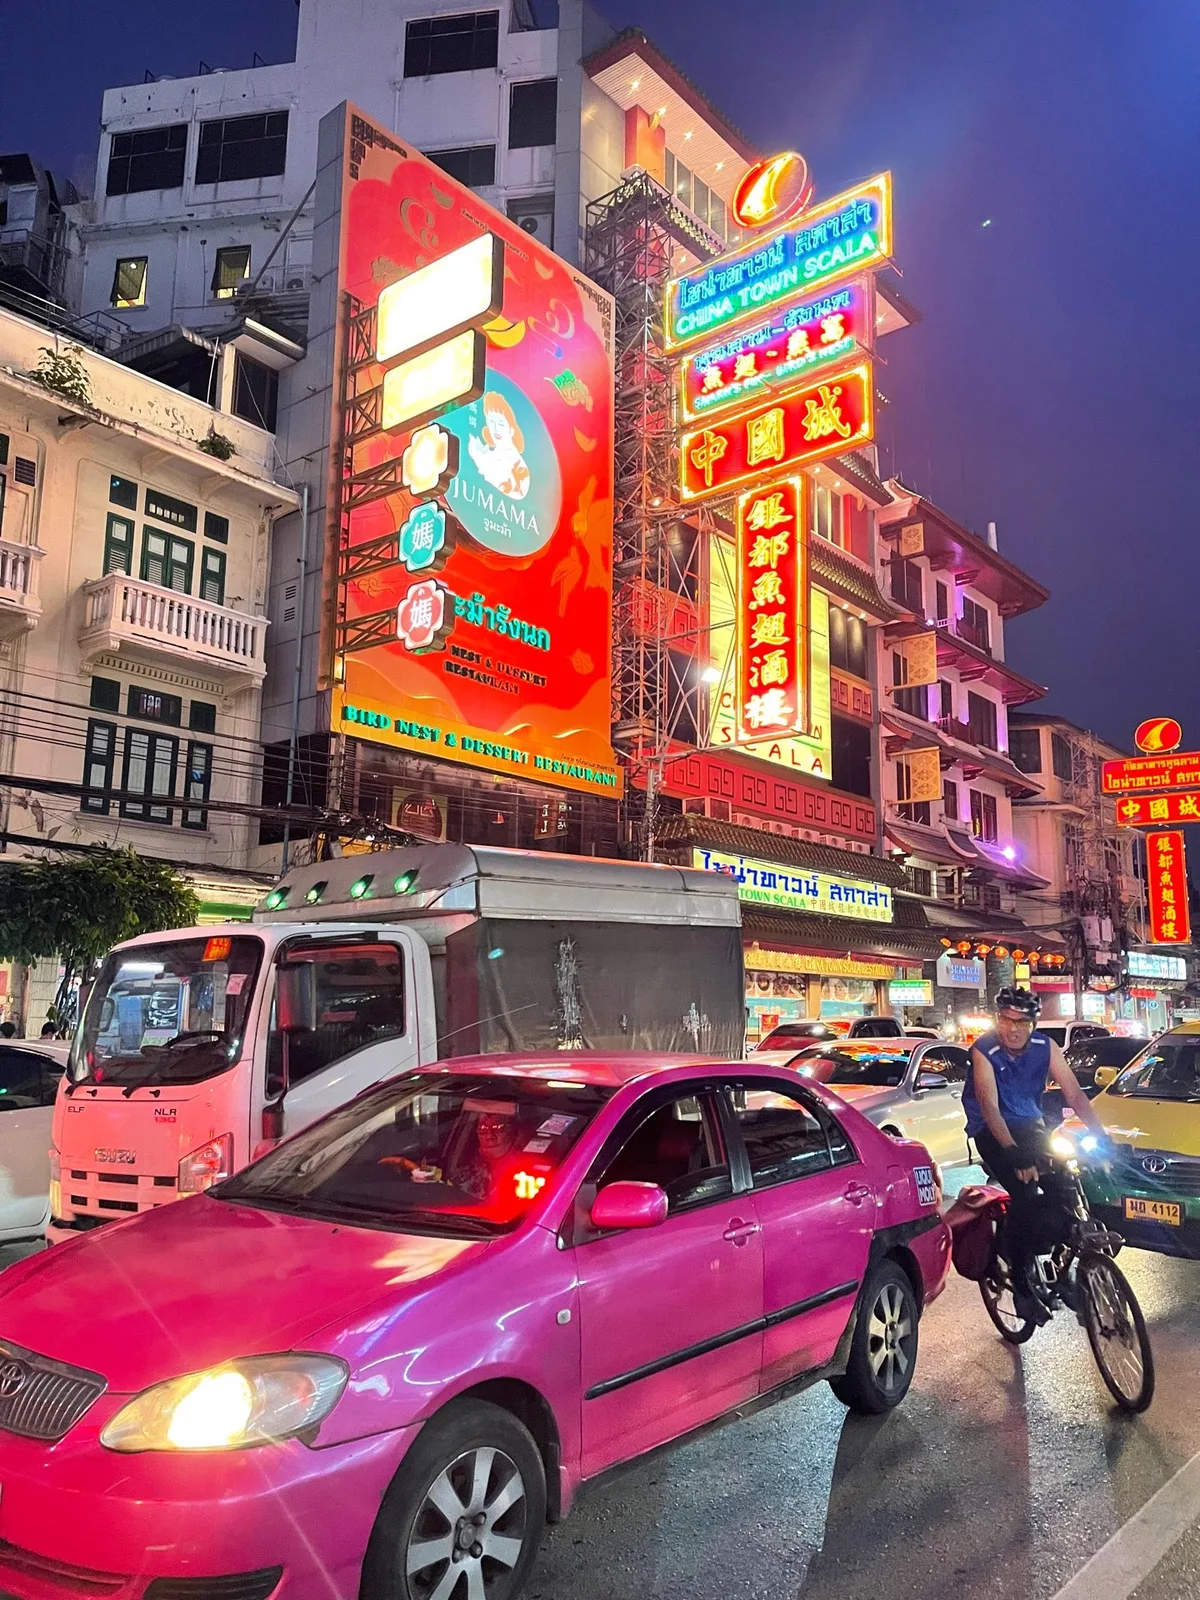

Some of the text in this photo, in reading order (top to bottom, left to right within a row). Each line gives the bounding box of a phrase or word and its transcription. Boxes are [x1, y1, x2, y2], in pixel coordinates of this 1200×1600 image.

[676, 232, 875, 335] CHINA TOWN SCALA
[691, 385, 851, 487] 中國城
[452, 477, 540, 535] JUMAMA
[444, 661, 519, 694] RESTAURANT
[451, 645, 482, 664] NEST
[497, 661, 547, 686] DESSERT
[343, 705, 391, 729] BIRD
[395, 719, 441, 742] NEST
[445, 732, 458, 747] &
[462, 736, 530, 764] DESSERT
[534, 755, 617, 787] RESTAURANT
[739, 888, 806, 909] TOWN SCALA
[830, 884, 888, 908] สกาล่า
[805, 959, 897, 978] CHINA TOWN SCALA RESTAURANT
[154, 1108, 177, 1116] NLR
[94, 1148, 136, 1164] ISUZU
[919, 1184, 936, 1203] MOLY
[1152, 1203, 1178, 1217] 4112
